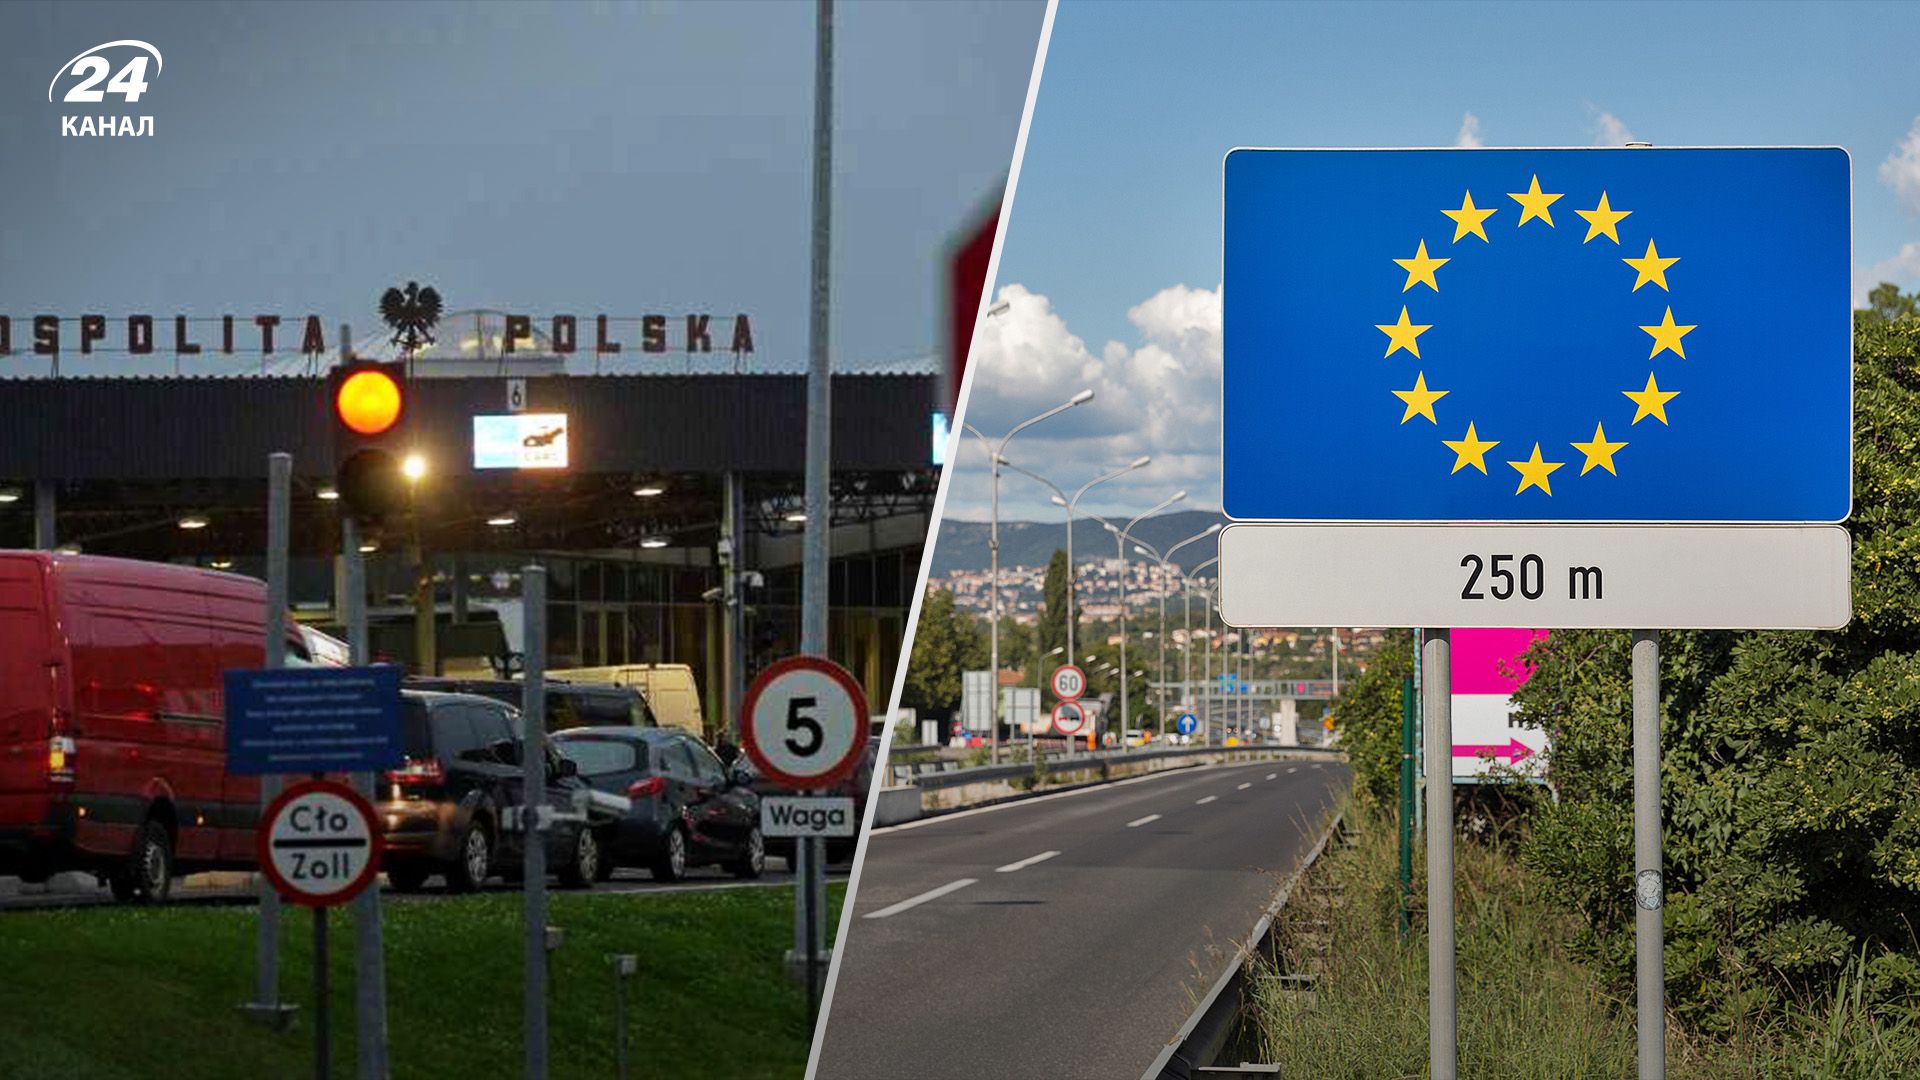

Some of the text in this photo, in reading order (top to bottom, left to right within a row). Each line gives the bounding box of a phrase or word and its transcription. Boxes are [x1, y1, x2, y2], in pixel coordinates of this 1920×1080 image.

[506, 314, 754, 354] POLSKA
[511, 383, 522, 407] 6
[1460, 553, 1603, 600] 250 m
[1059, 674, 1079, 692] 60
[785, 696, 824, 757] 5
[289, 805, 348, 832] Cło
[769, 805, 845, 831] Waga
[291, 852, 349, 879] Zoll
